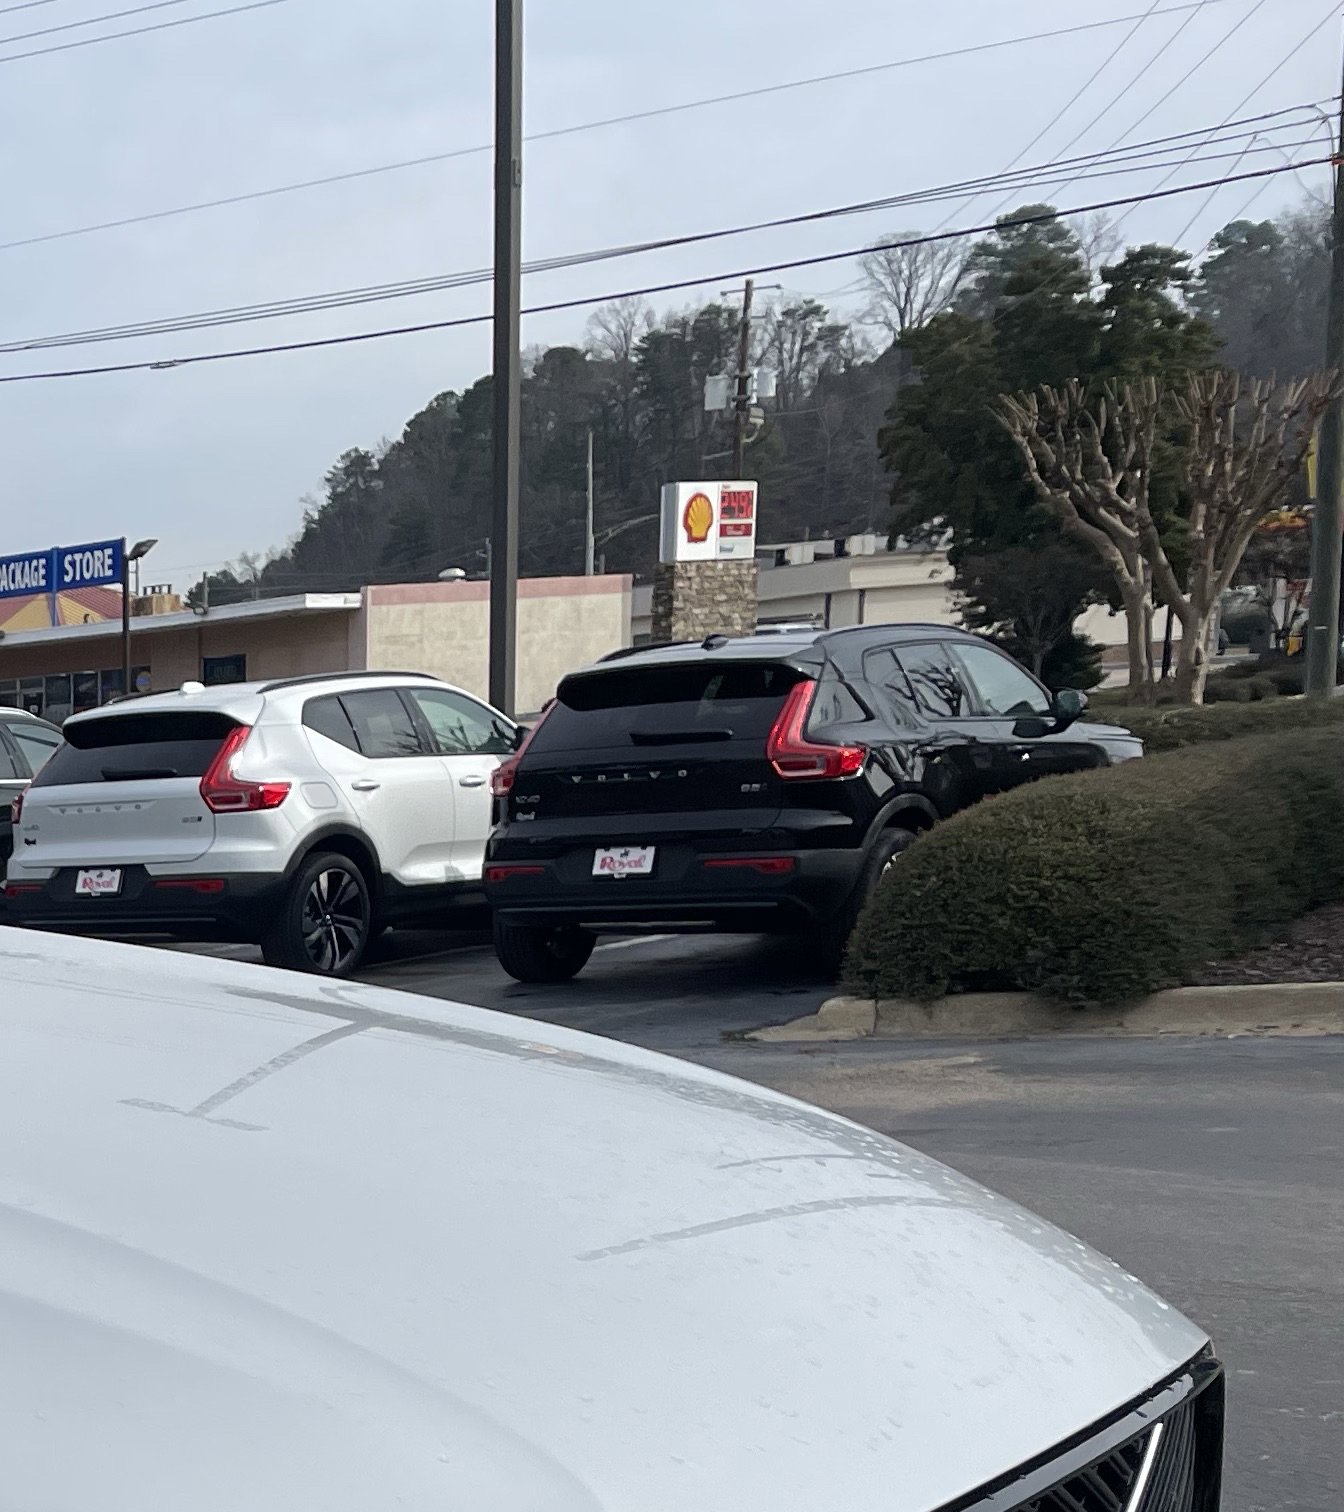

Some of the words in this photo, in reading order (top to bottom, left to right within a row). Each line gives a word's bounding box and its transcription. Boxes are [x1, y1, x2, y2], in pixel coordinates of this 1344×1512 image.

[64, 548, 114, 583] STORE
[600, 855, 646, 871] Royal
[82, 876, 116, 891] Royal
